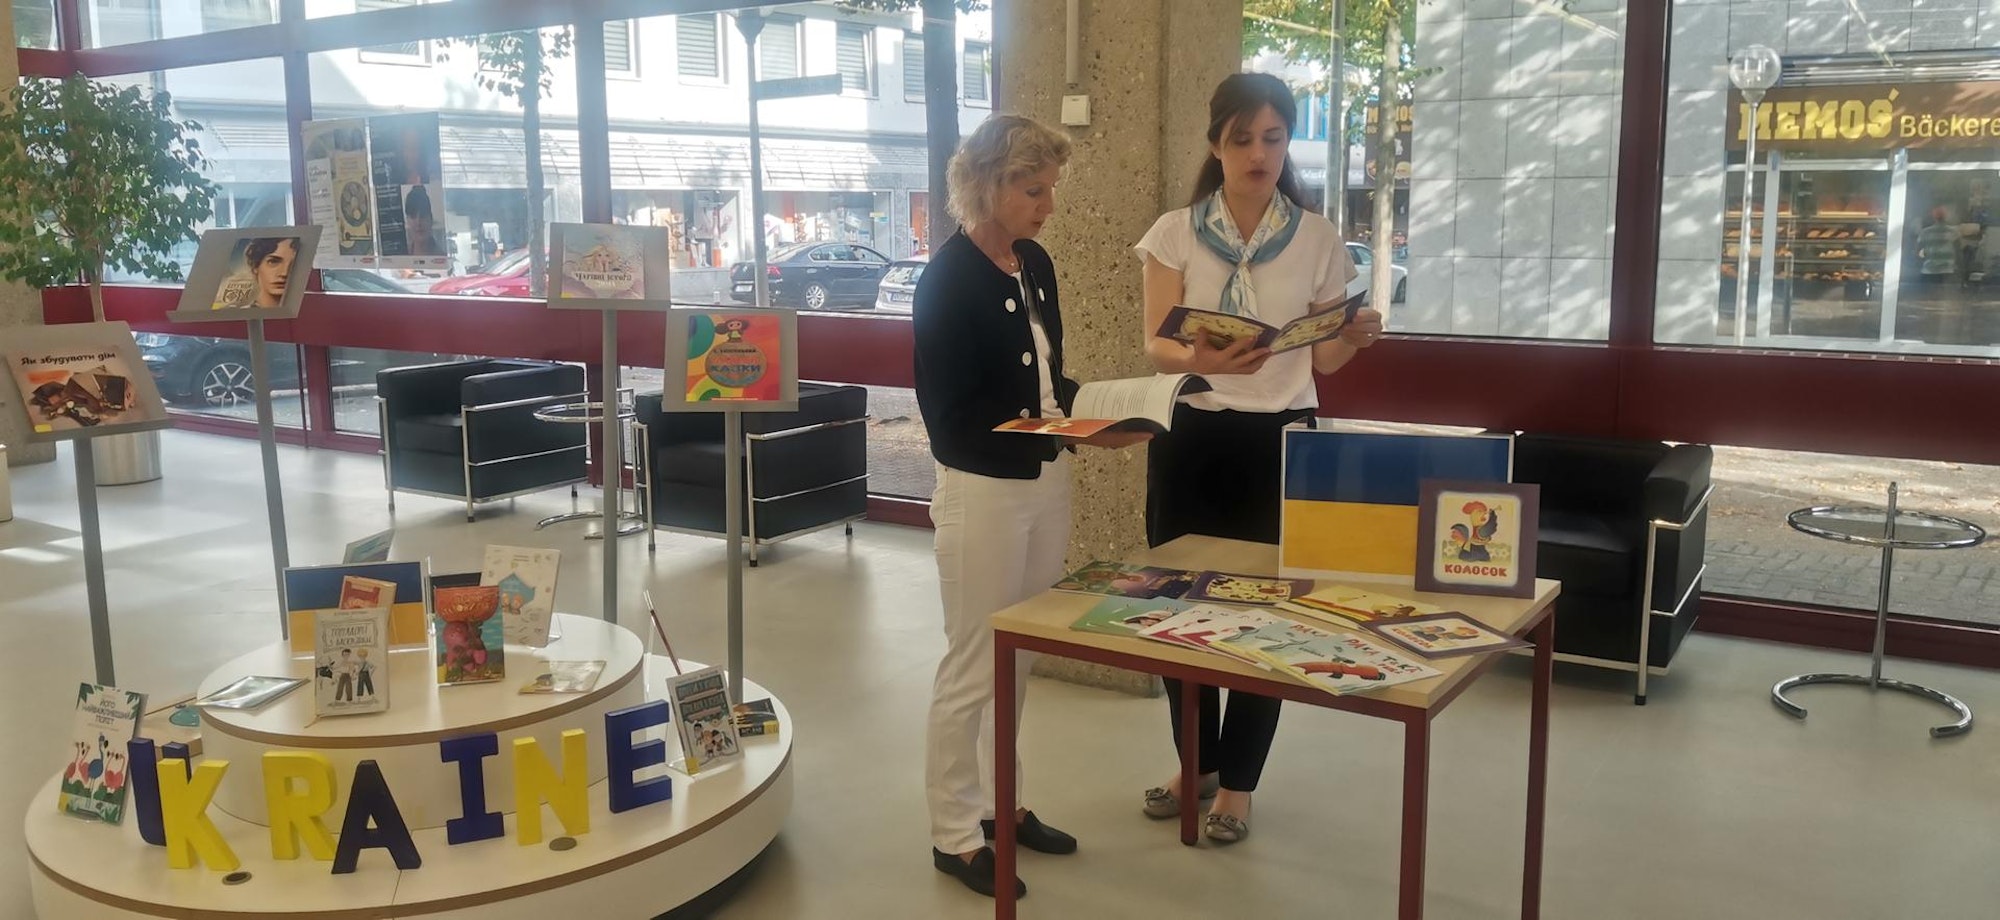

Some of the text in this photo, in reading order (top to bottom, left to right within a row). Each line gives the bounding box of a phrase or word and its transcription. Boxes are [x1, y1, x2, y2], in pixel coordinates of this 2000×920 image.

[20, 352, 116, 366] Як збудувати дім
[1444, 564, 1508, 577] КОЛОСОК
[127, 700, 673, 874] UKRAINE
